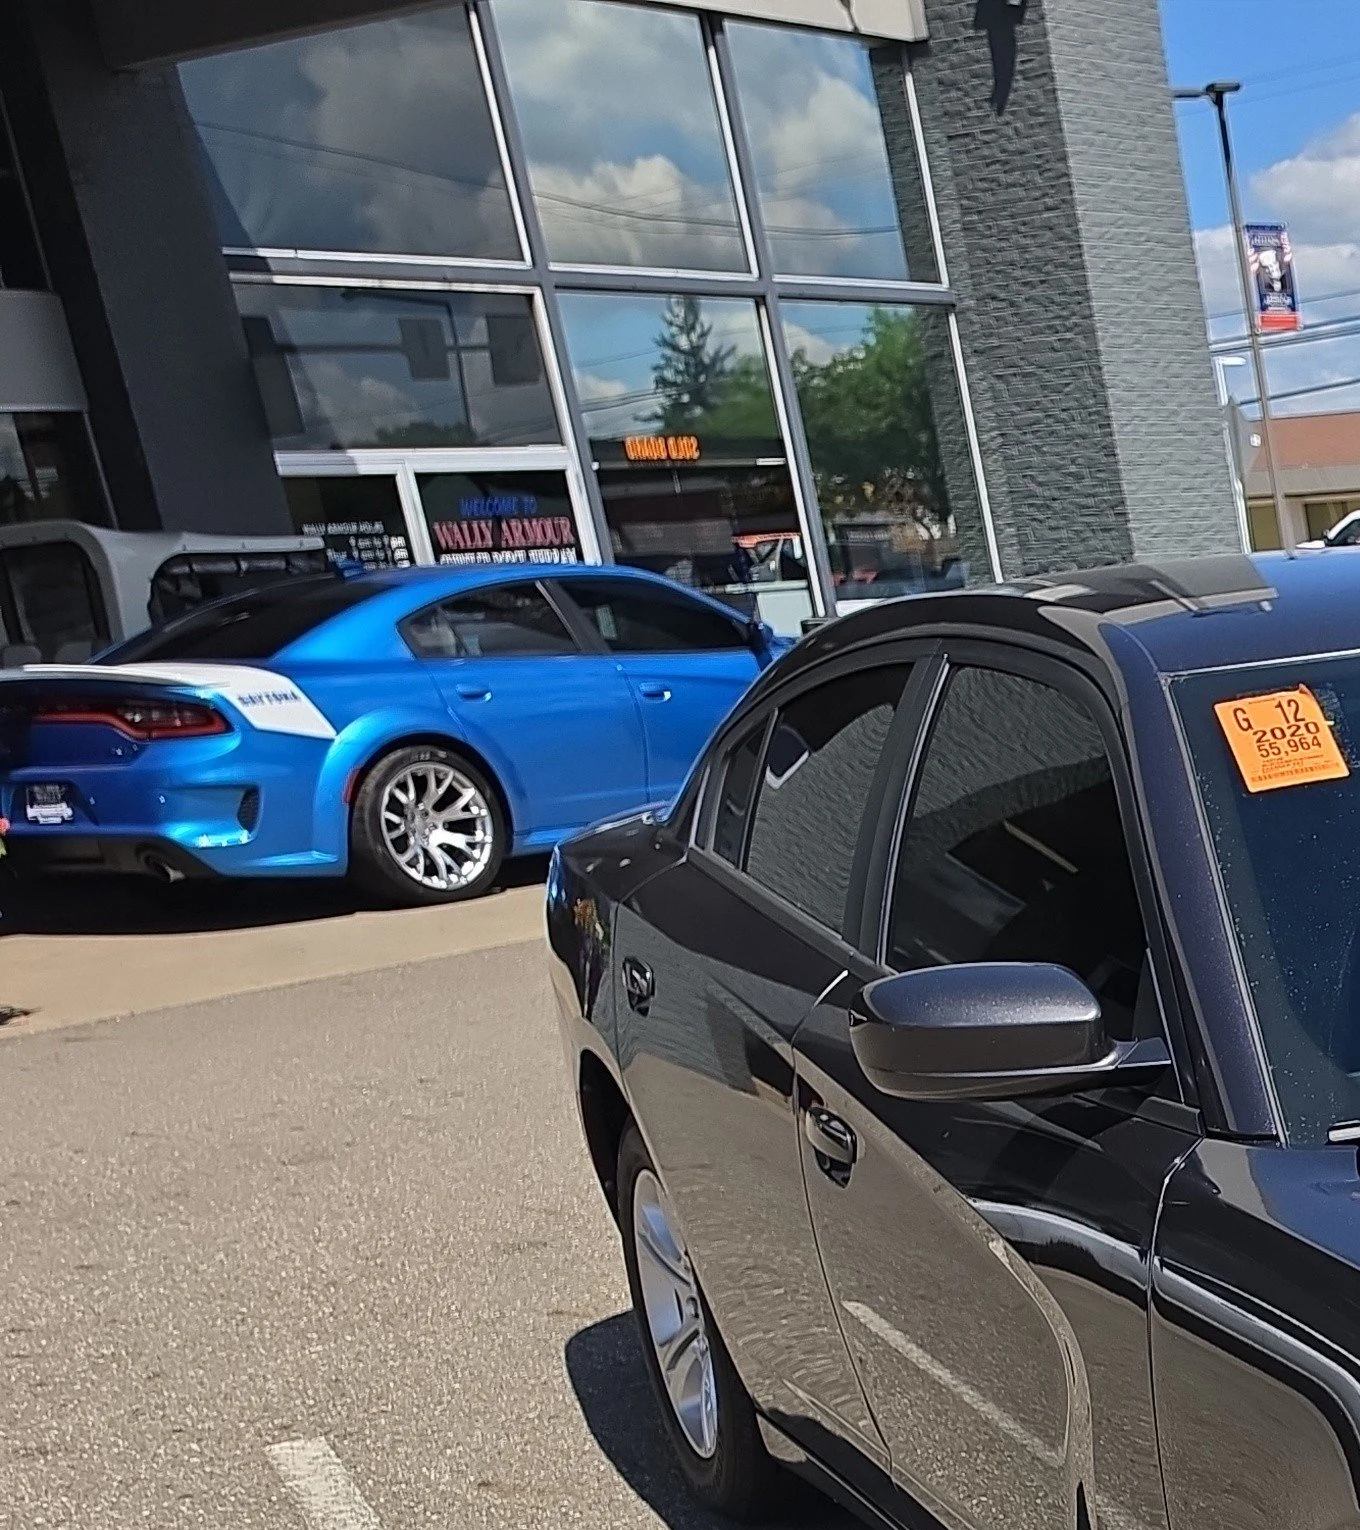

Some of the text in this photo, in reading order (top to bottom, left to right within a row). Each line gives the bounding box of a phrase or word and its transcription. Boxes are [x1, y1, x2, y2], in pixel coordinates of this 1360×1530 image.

[433, 519, 494, 550] WALLY
[500, 516, 577, 548] ARMOUR
[1232, 698, 1306, 732] G 12
[1251, 721, 1321, 744] 2020
[1256, 735, 1322, 758] 55,964
